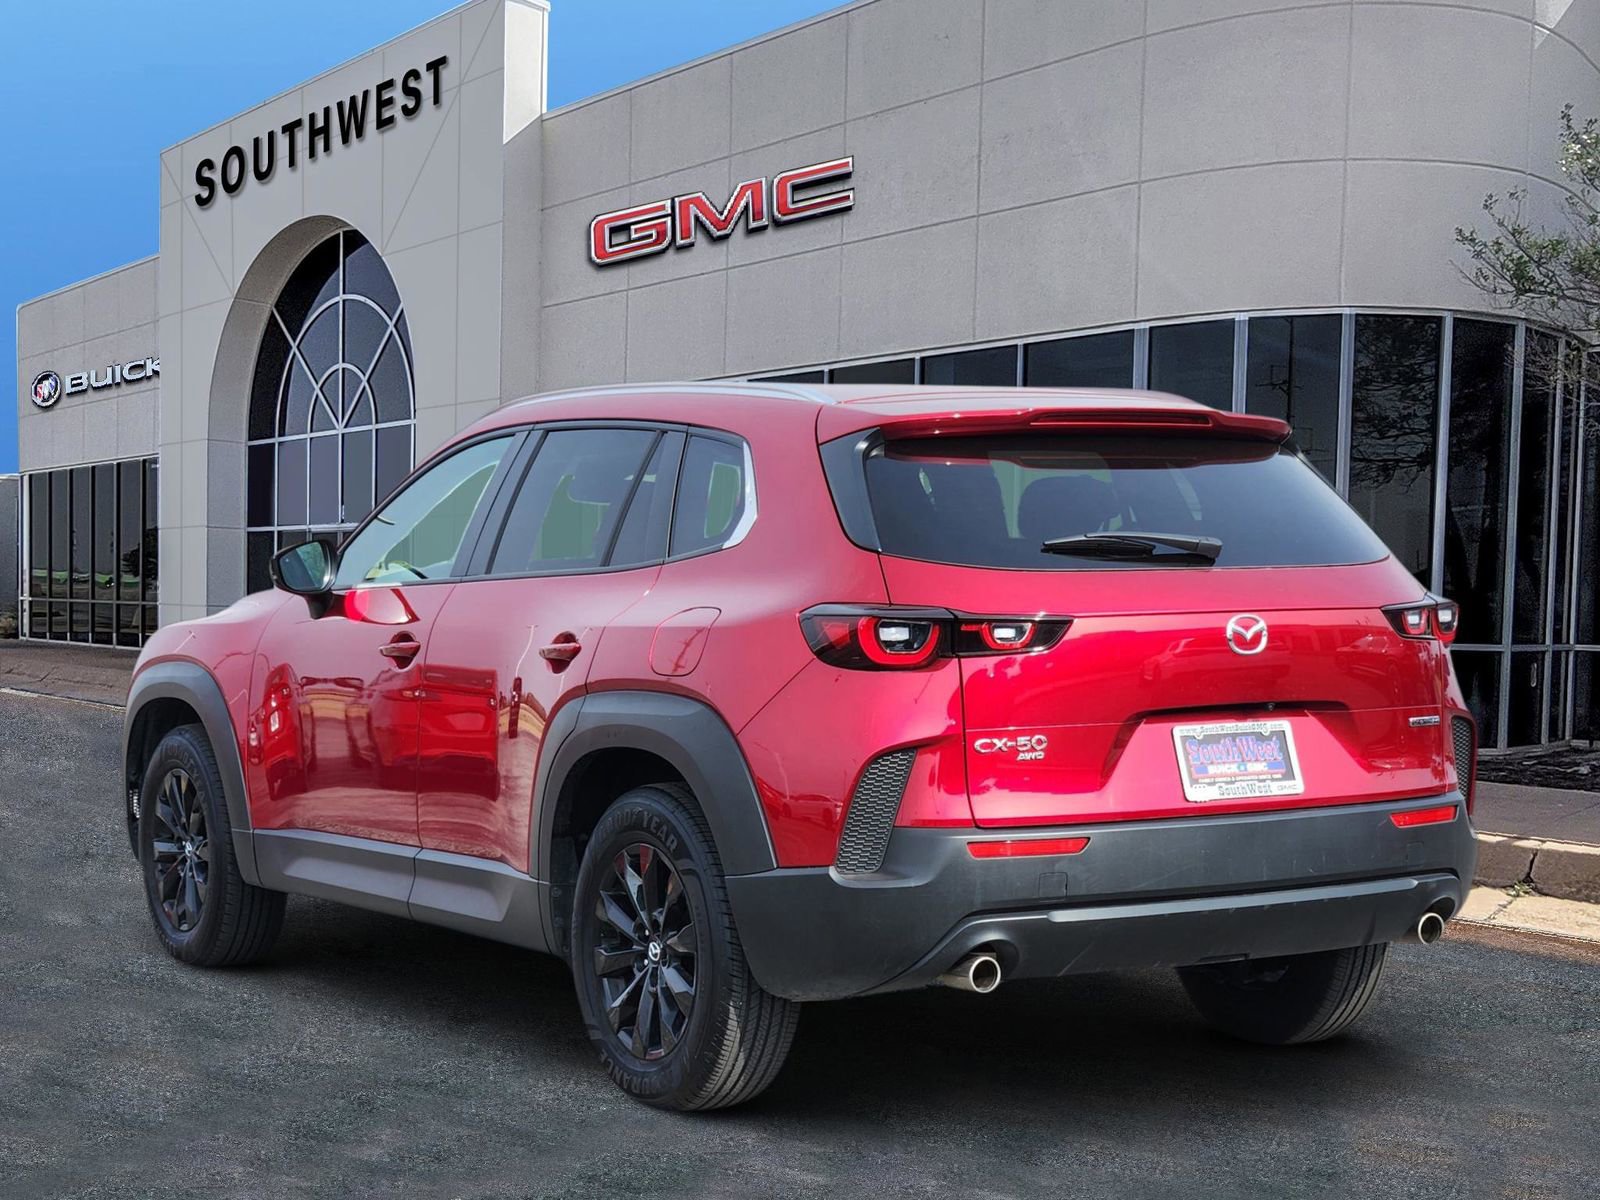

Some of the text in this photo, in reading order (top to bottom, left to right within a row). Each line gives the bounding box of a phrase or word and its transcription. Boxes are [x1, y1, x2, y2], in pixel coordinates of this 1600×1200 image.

[194, 55, 449, 207] SOUTHWEST
[589, 155, 855, 265] GMC
[64, 357, 160, 396] BUICK
[974, 734, 1048, 753] CX-50
[1016, 750, 1045, 761] AWD
[1217, 783, 1273, 797] SouthWest
